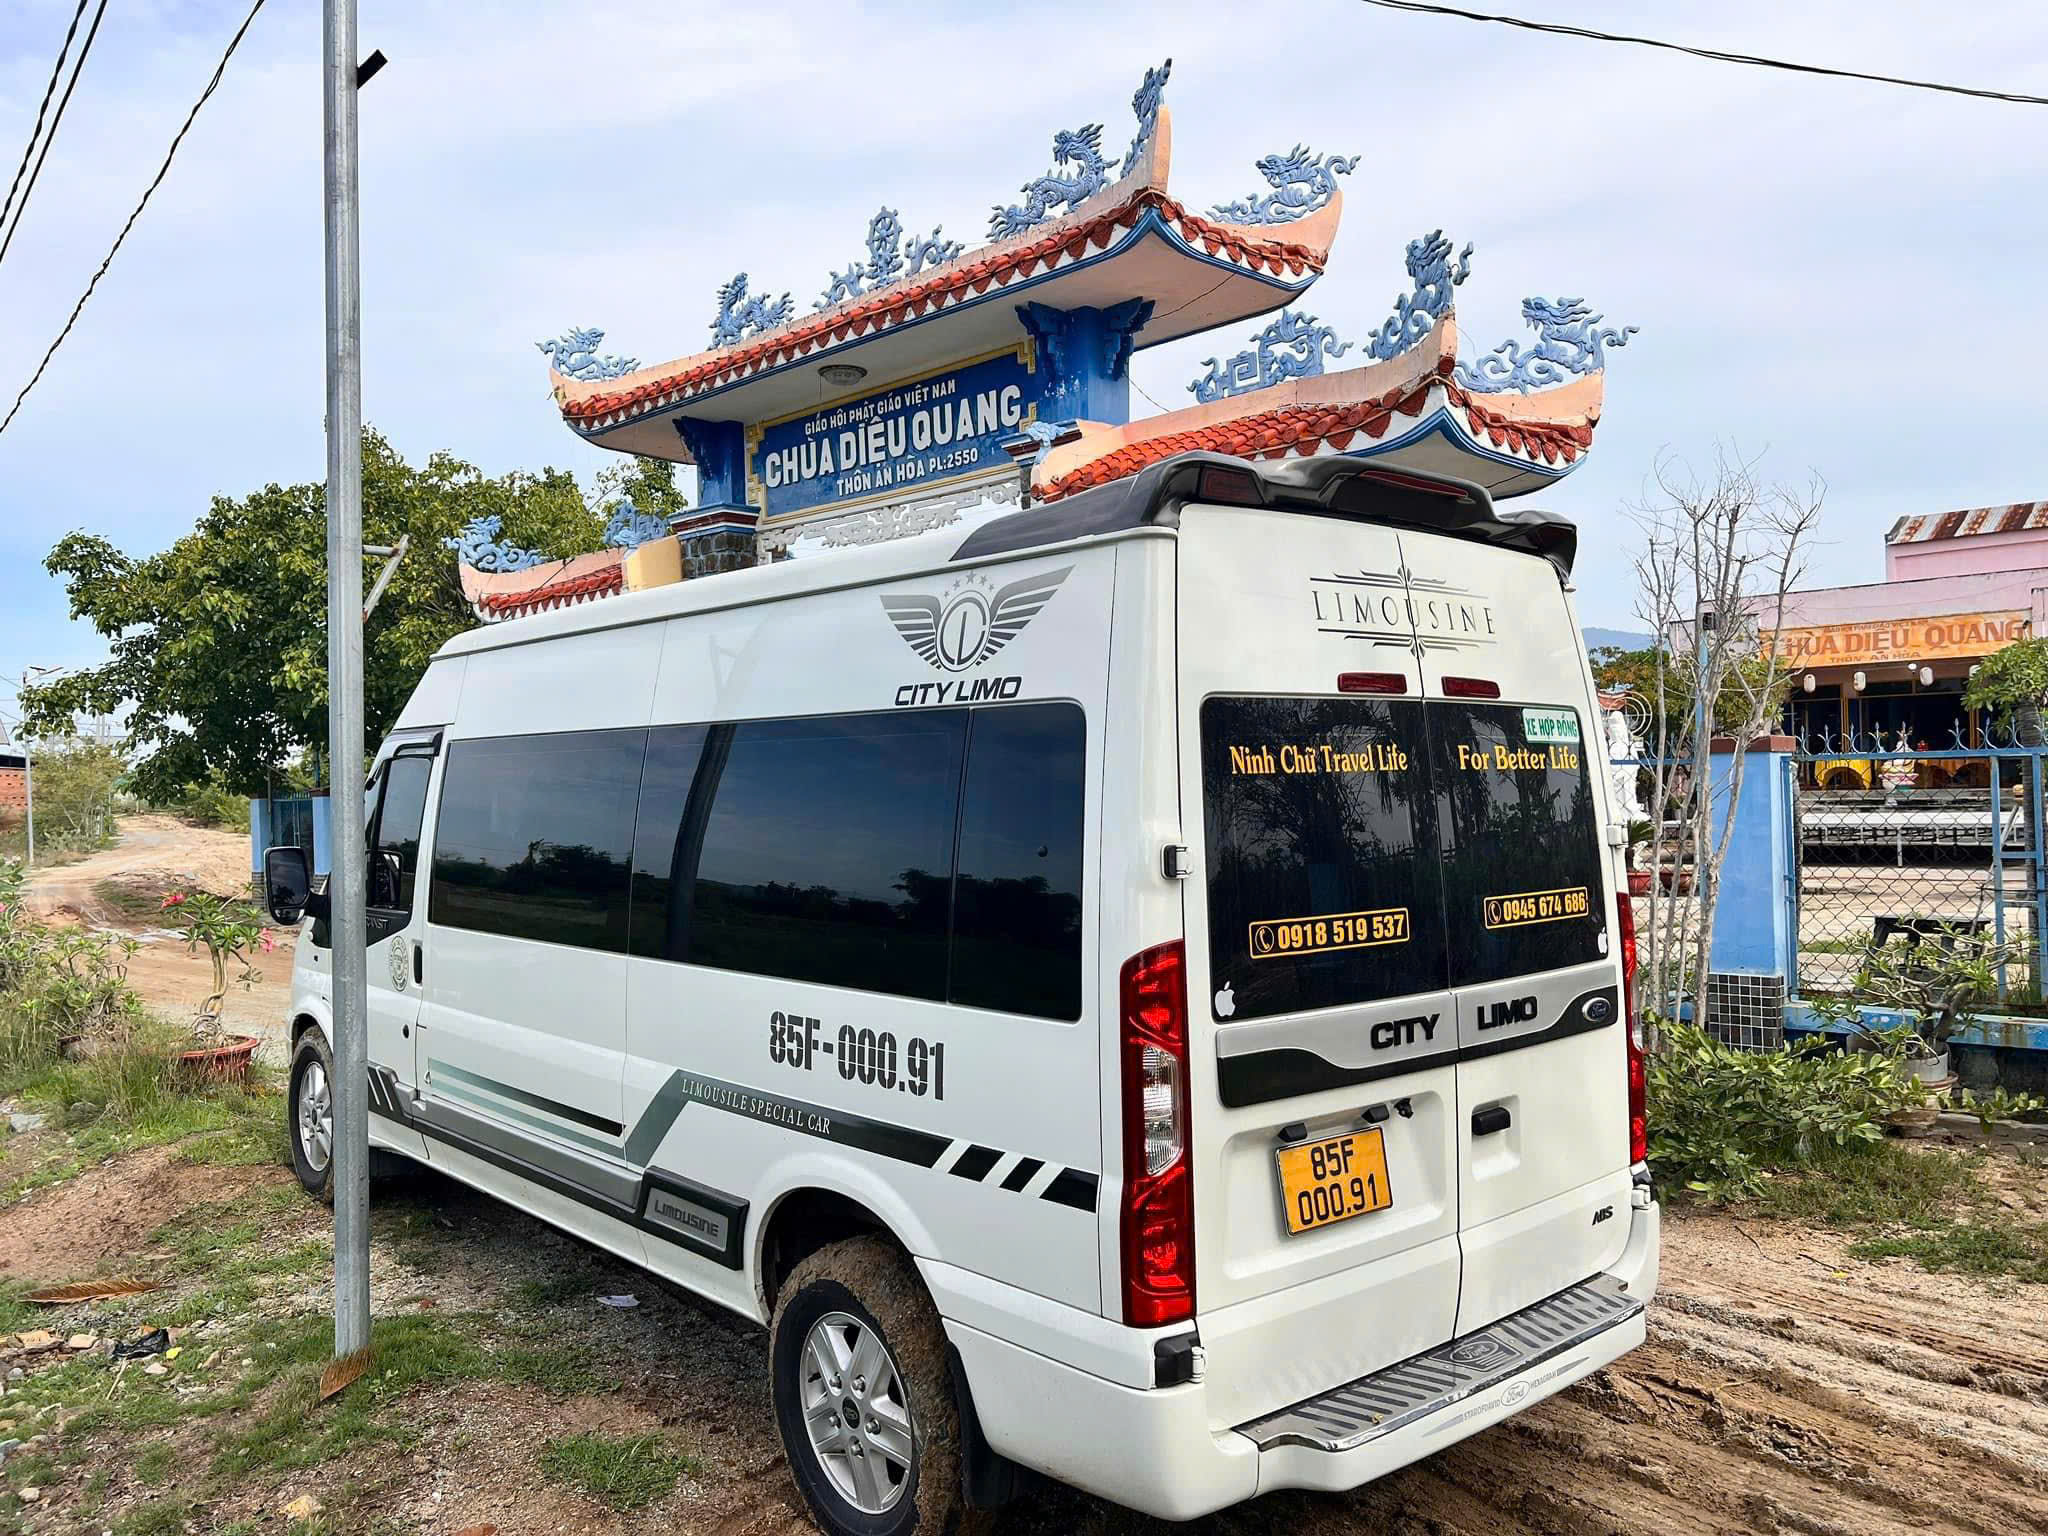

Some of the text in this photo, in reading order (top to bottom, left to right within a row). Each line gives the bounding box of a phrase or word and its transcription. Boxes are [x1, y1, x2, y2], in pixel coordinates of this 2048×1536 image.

[805, 379, 956, 436] GIÁO HỘI PHẬT GIÁO VIỆT NAM
[765, 384, 1023, 488] CHÙA DIỆU QUANG
[837, 469, 872, 497] THÔN
[929, 447, 979, 473] PL:2550
[1312, 590, 1496, 635] LIMOUSINE
[1763, 630, 1840, 658] HÙA
[1924, 619, 2024, 650] QUANG
[895, 676, 1023, 706] CITY LIMO
[1525, 717, 1538, 736] XE
[1539, 716, 1555, 737] HỢP
[1229, 743, 1408, 774] Ninh Chữ Travel Life
[1457, 744, 1578, 770] For Better Life
[1503, 892, 1586, 921] 0945 674 686
[1278, 914, 1405, 949] 0918 519 537
[1370, 996, 1538, 1050] CITY LIMO
[769, 1010, 945, 1101] 85F-000.91
[682, 1079, 831, 1136] LIMOUSILE SPECIAL CAR
[1311, 1138, 1354, 1181] 85F
[1298, 1173, 1378, 1226] 000.91
